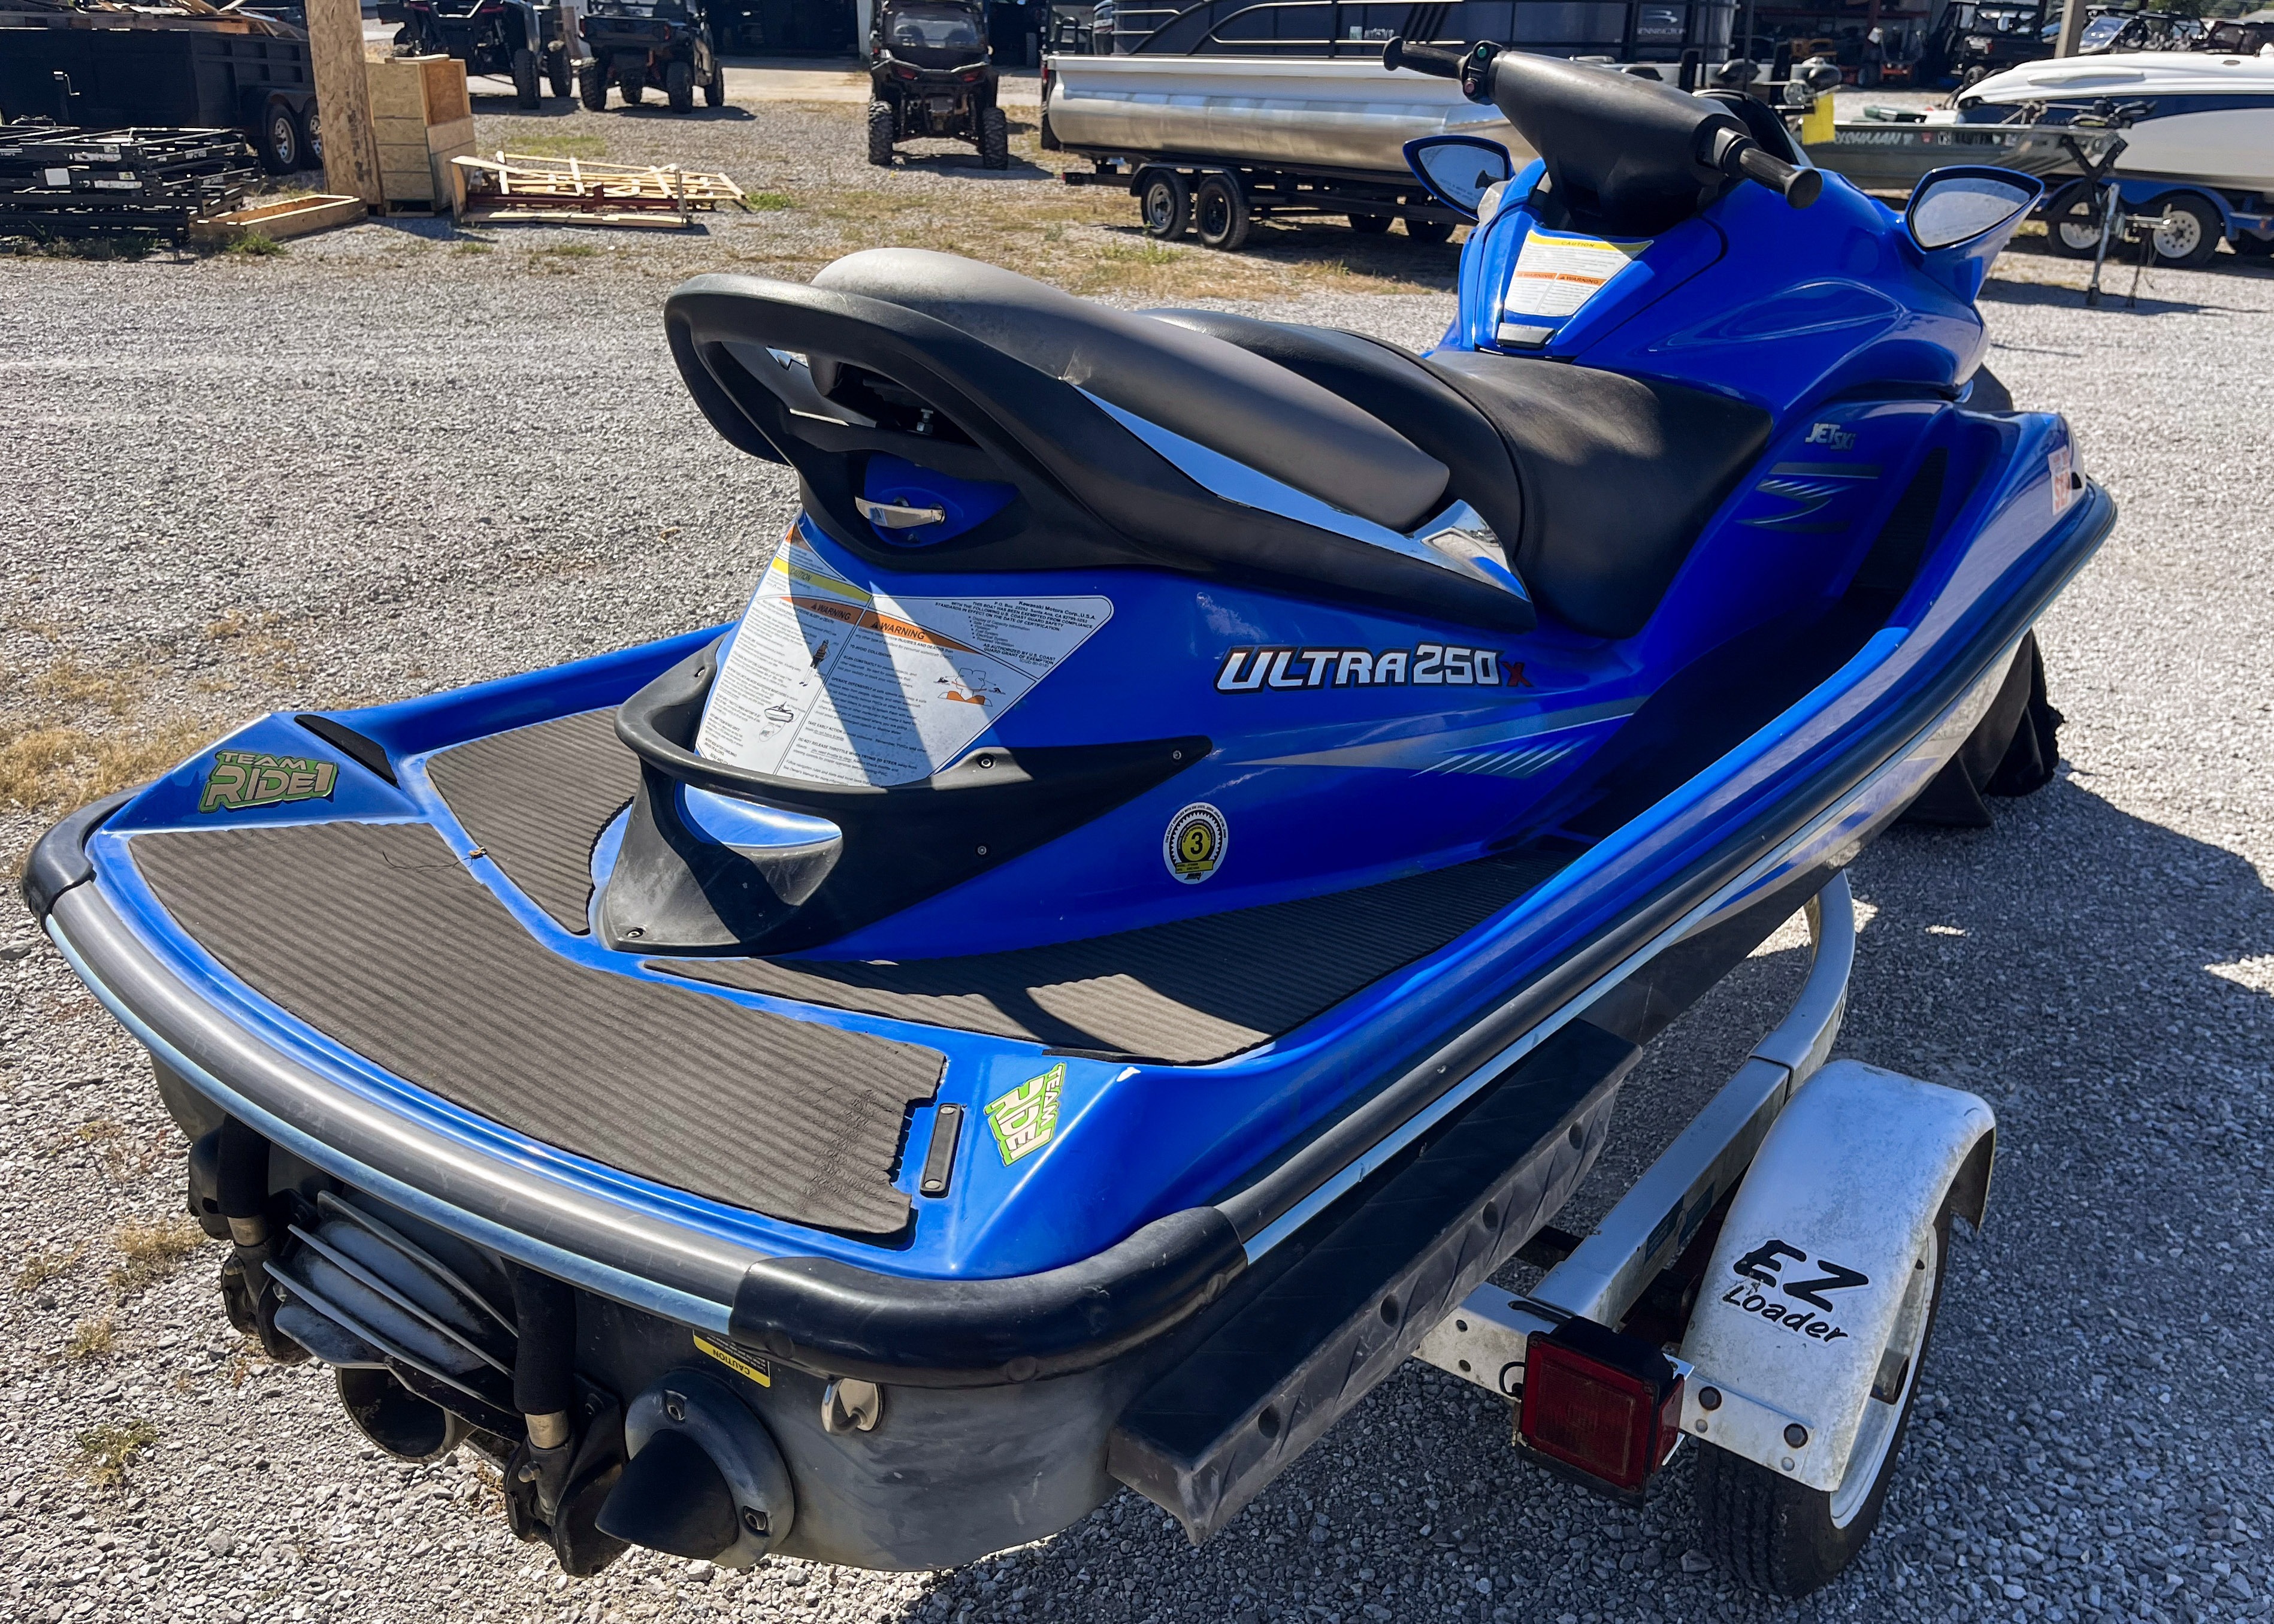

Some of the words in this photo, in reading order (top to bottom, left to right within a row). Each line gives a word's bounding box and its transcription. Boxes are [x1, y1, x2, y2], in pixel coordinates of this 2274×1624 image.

[1565, 276, 1599, 285] WARNING
[1805, 423, 1840, 443] JET
[790, 569, 812, 582] CAUTION
[818, 603, 851, 621] WARNING
[934, 601, 961, 611] STANDARDS
[972, 605, 999, 614] FOLLOWING
[1018, 600, 1044, 610] Kawasaki
[1020, 611, 1045, 619] EXEMPTED
[1062, 619, 1093, 629] COMPLIANCE
[880, 622, 926, 640] WARNING
[990, 645, 1021, 654] AUTHORIZED
[1026, 655, 1054, 664] EXEMPTION
[1215, 649, 1409, 691] ULTRA
[222, 752, 306, 770] TEAM
[1190, 831, 1203, 855] 3
[1039, 1064, 1063, 1127] TEAM
[1732, 1239, 1870, 1313] EZ
[1722, 1284, 1849, 1344] Loader
[713, 1348, 750, 1375] CAUTION
